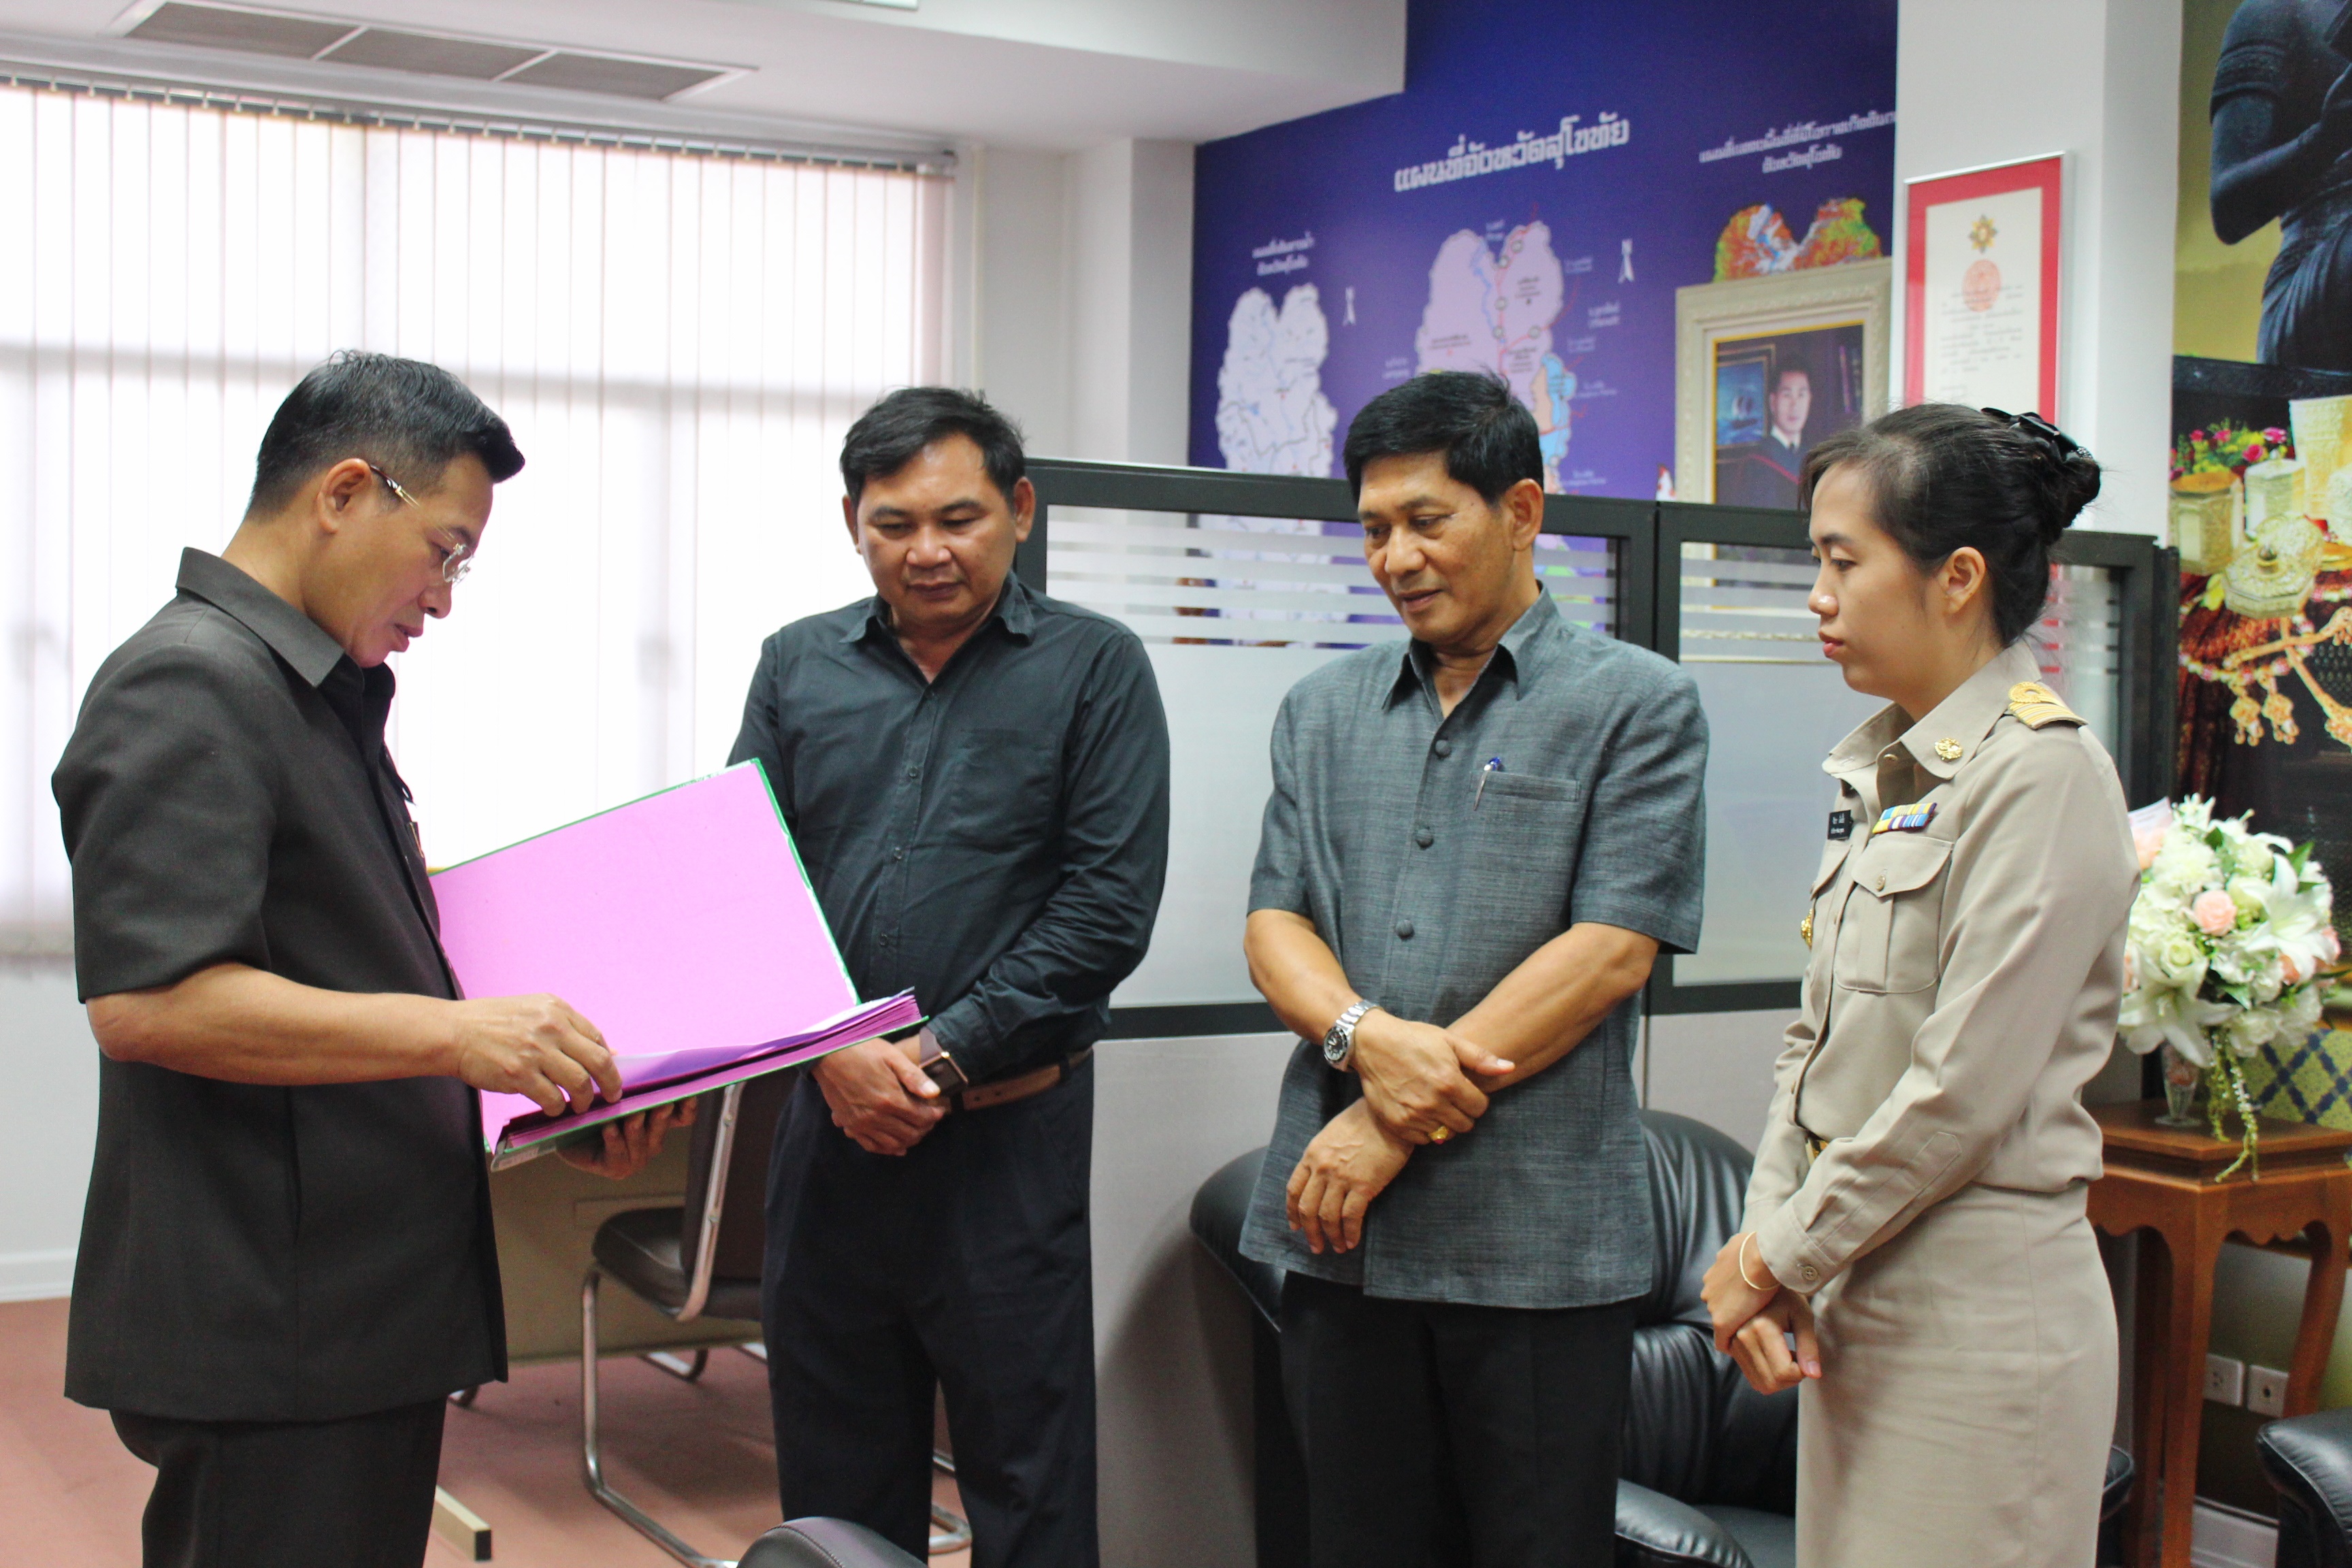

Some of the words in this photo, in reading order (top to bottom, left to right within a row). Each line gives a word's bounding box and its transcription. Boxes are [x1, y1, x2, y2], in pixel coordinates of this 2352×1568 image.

[1394, 112, 1630, 192] แผนที่จังหวัดสุโขทัย
